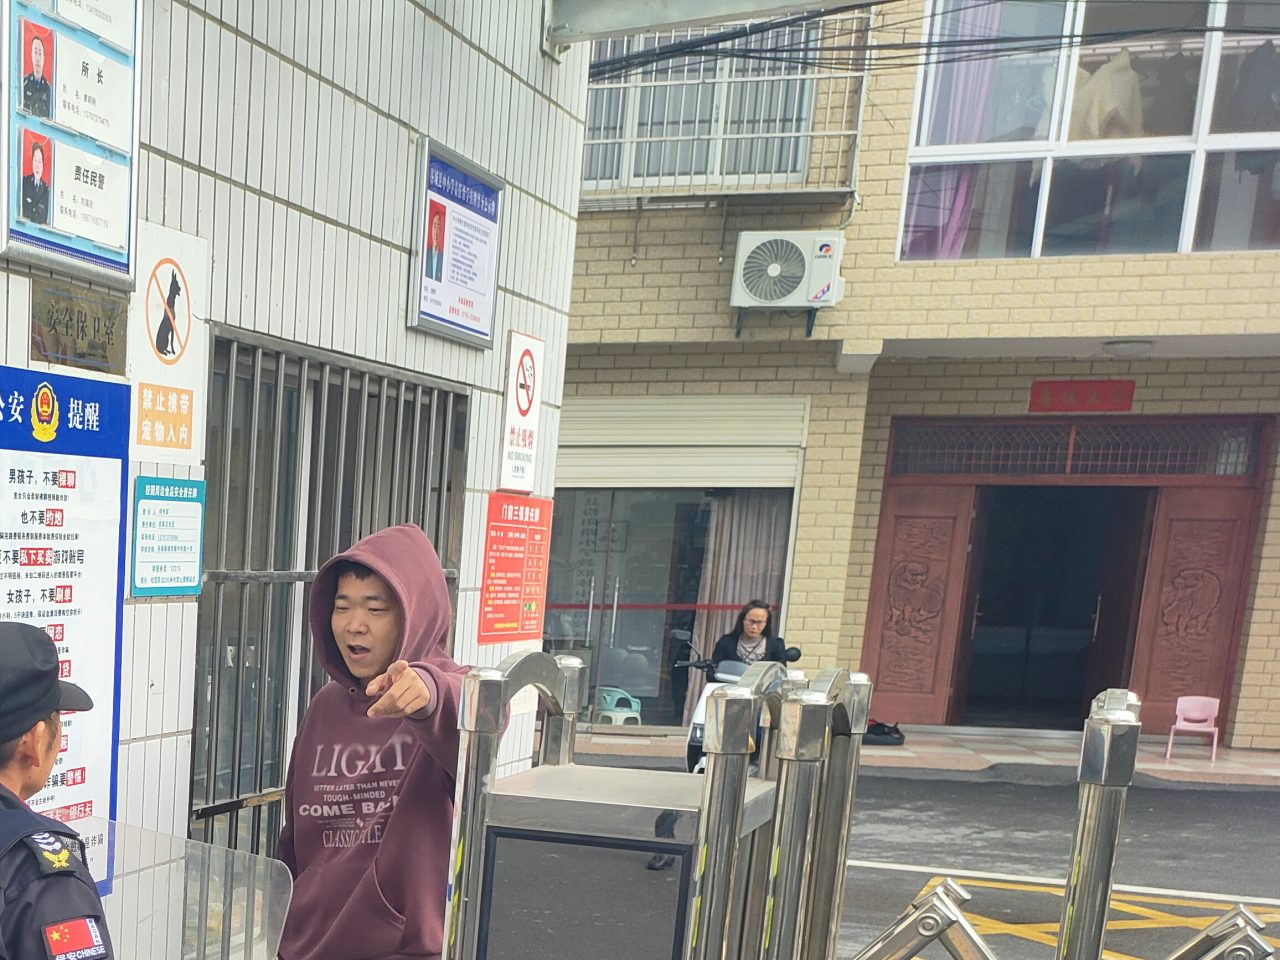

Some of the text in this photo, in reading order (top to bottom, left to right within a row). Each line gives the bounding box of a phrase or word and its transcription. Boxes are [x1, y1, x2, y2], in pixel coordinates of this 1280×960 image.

[74, 165, 105, 190] 责任民警
[142, 388, 189, 415] 禁止携带
[68, 397, 100, 431] 提醒
[141, 420, 188, 445] 宠物入内
[20, 509, 63, 526] 也不要约炮
[6, 586, 72, 604] 女孩子，不要刷单
[298, 803, 355, 817] COME
[76, 945, 106, 960] CHINESE
